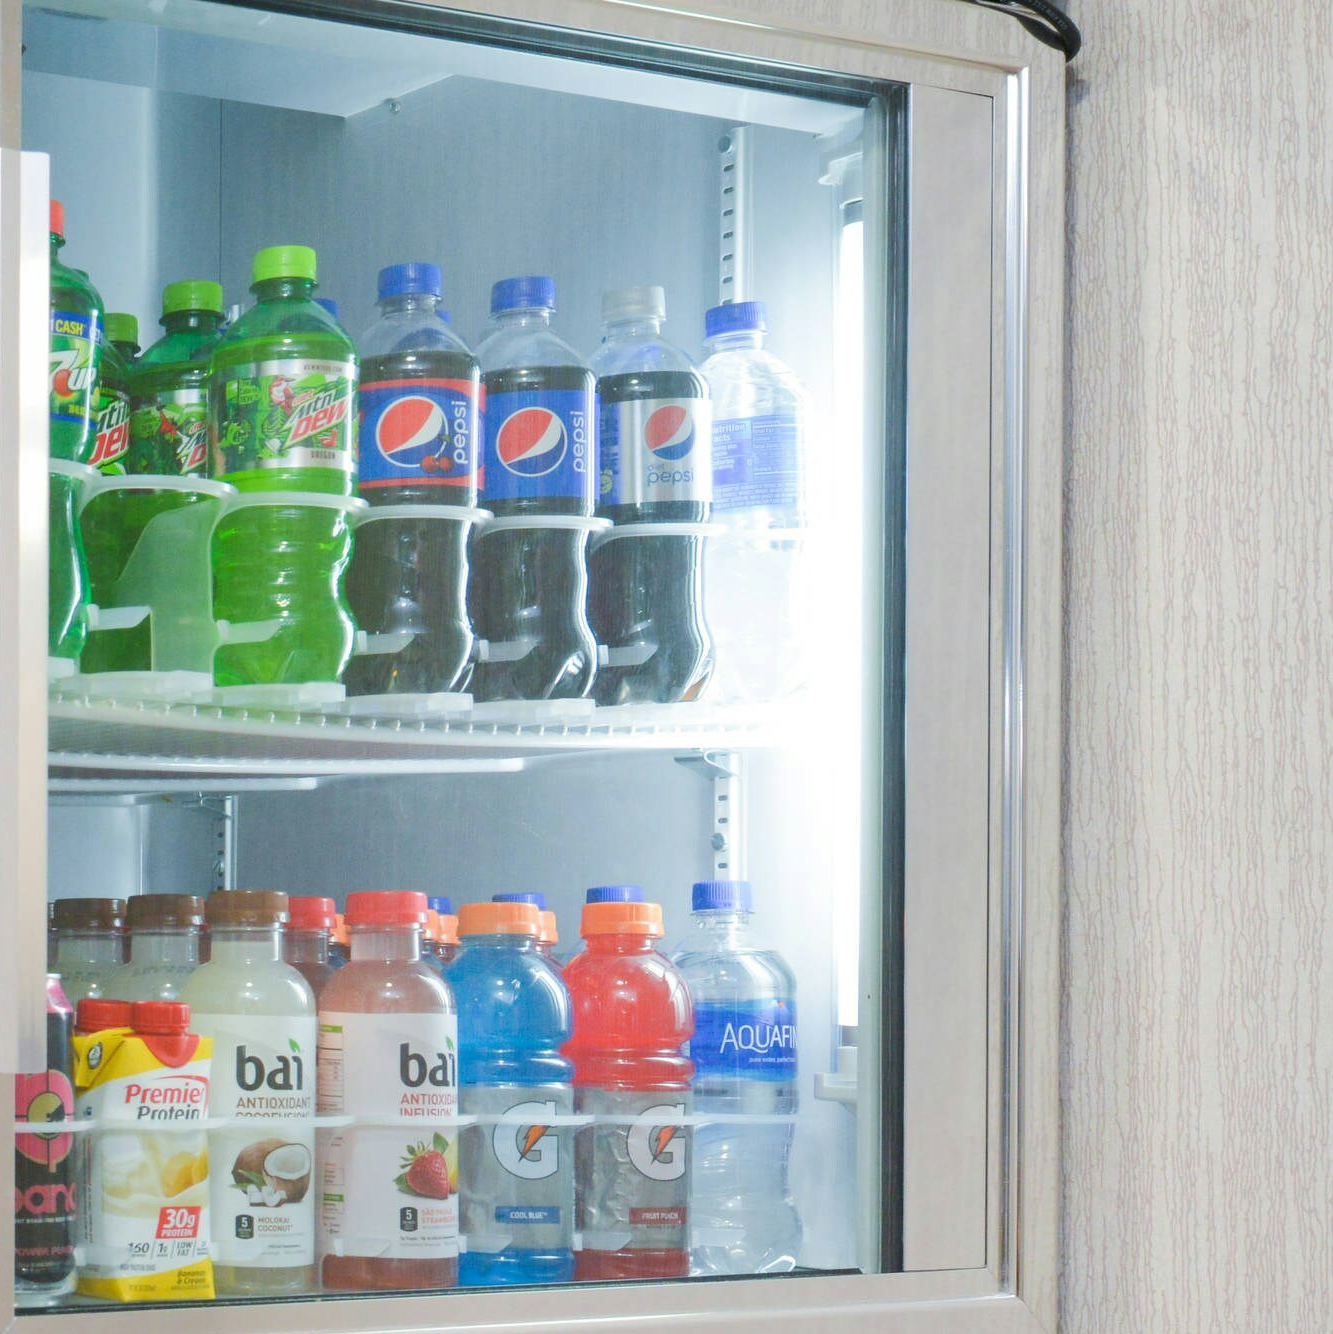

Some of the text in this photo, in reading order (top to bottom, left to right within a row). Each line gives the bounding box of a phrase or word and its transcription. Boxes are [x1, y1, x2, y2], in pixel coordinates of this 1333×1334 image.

[56, 320, 85, 335] CASH
[452, 401, 468, 464] pepsi
[570, 411, 586, 473] pepsi
[236, 1042, 304, 1092] bai
[137, 1104, 201, 1120] Protein
[493, 1101, 559, 1179] G
[627, 1103, 686, 1181] G
[163, 1209, 196, 1229] 30g
